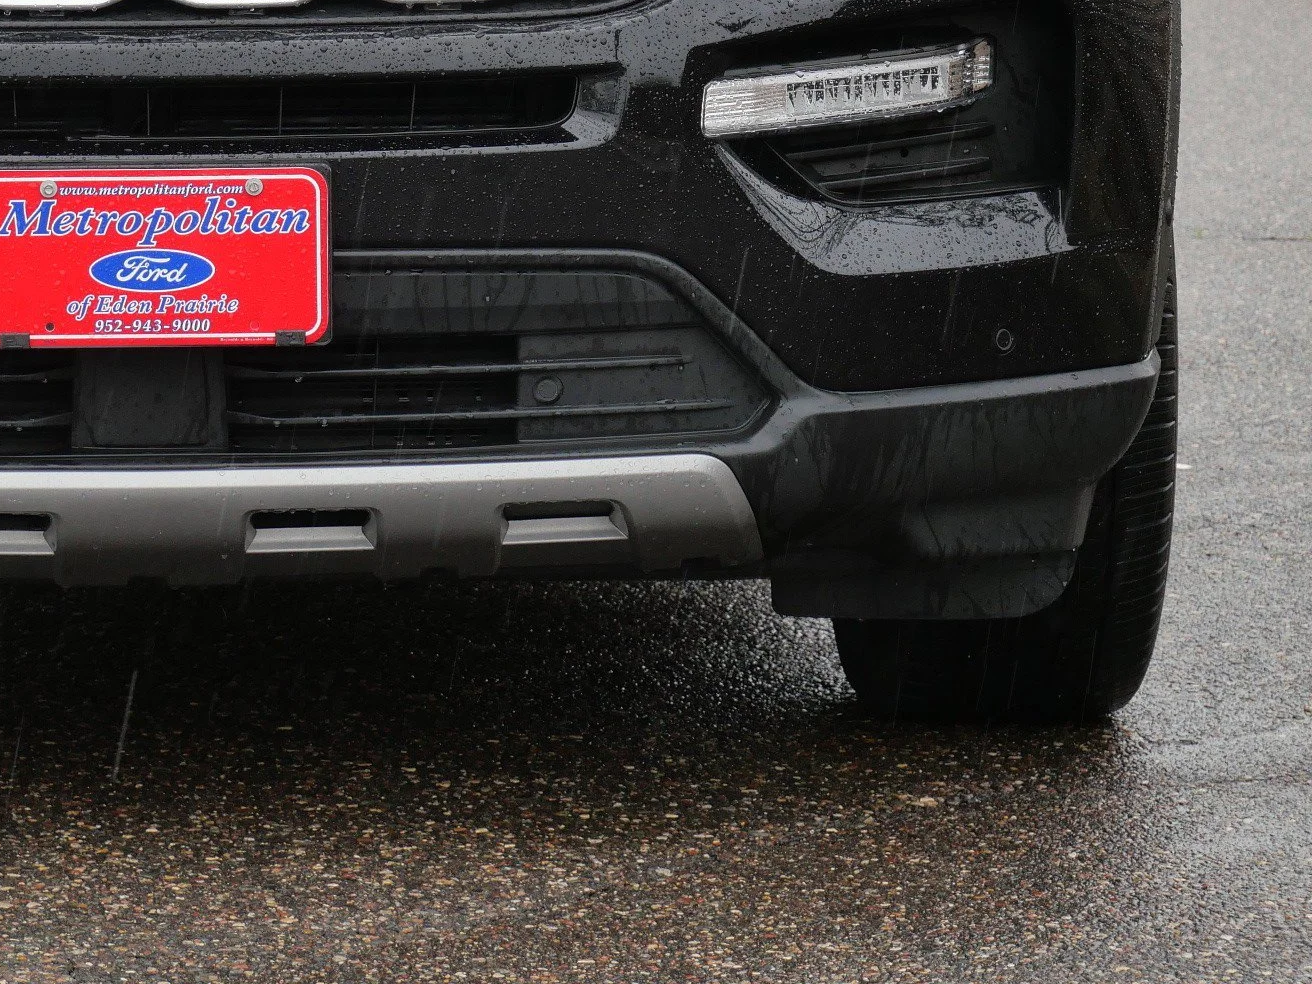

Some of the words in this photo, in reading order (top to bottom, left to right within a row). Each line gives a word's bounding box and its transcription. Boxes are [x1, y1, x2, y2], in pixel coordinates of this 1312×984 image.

[59, 183, 243, 197] www.metropolitanford.com
[117, 255, 187, 283] Ford
[66, 295, 94, 321] of
[94, 295, 152, 314] Eden
[156, 294, 239, 314] Prairie
[94, 319, 211, 333] 952-943-9000
